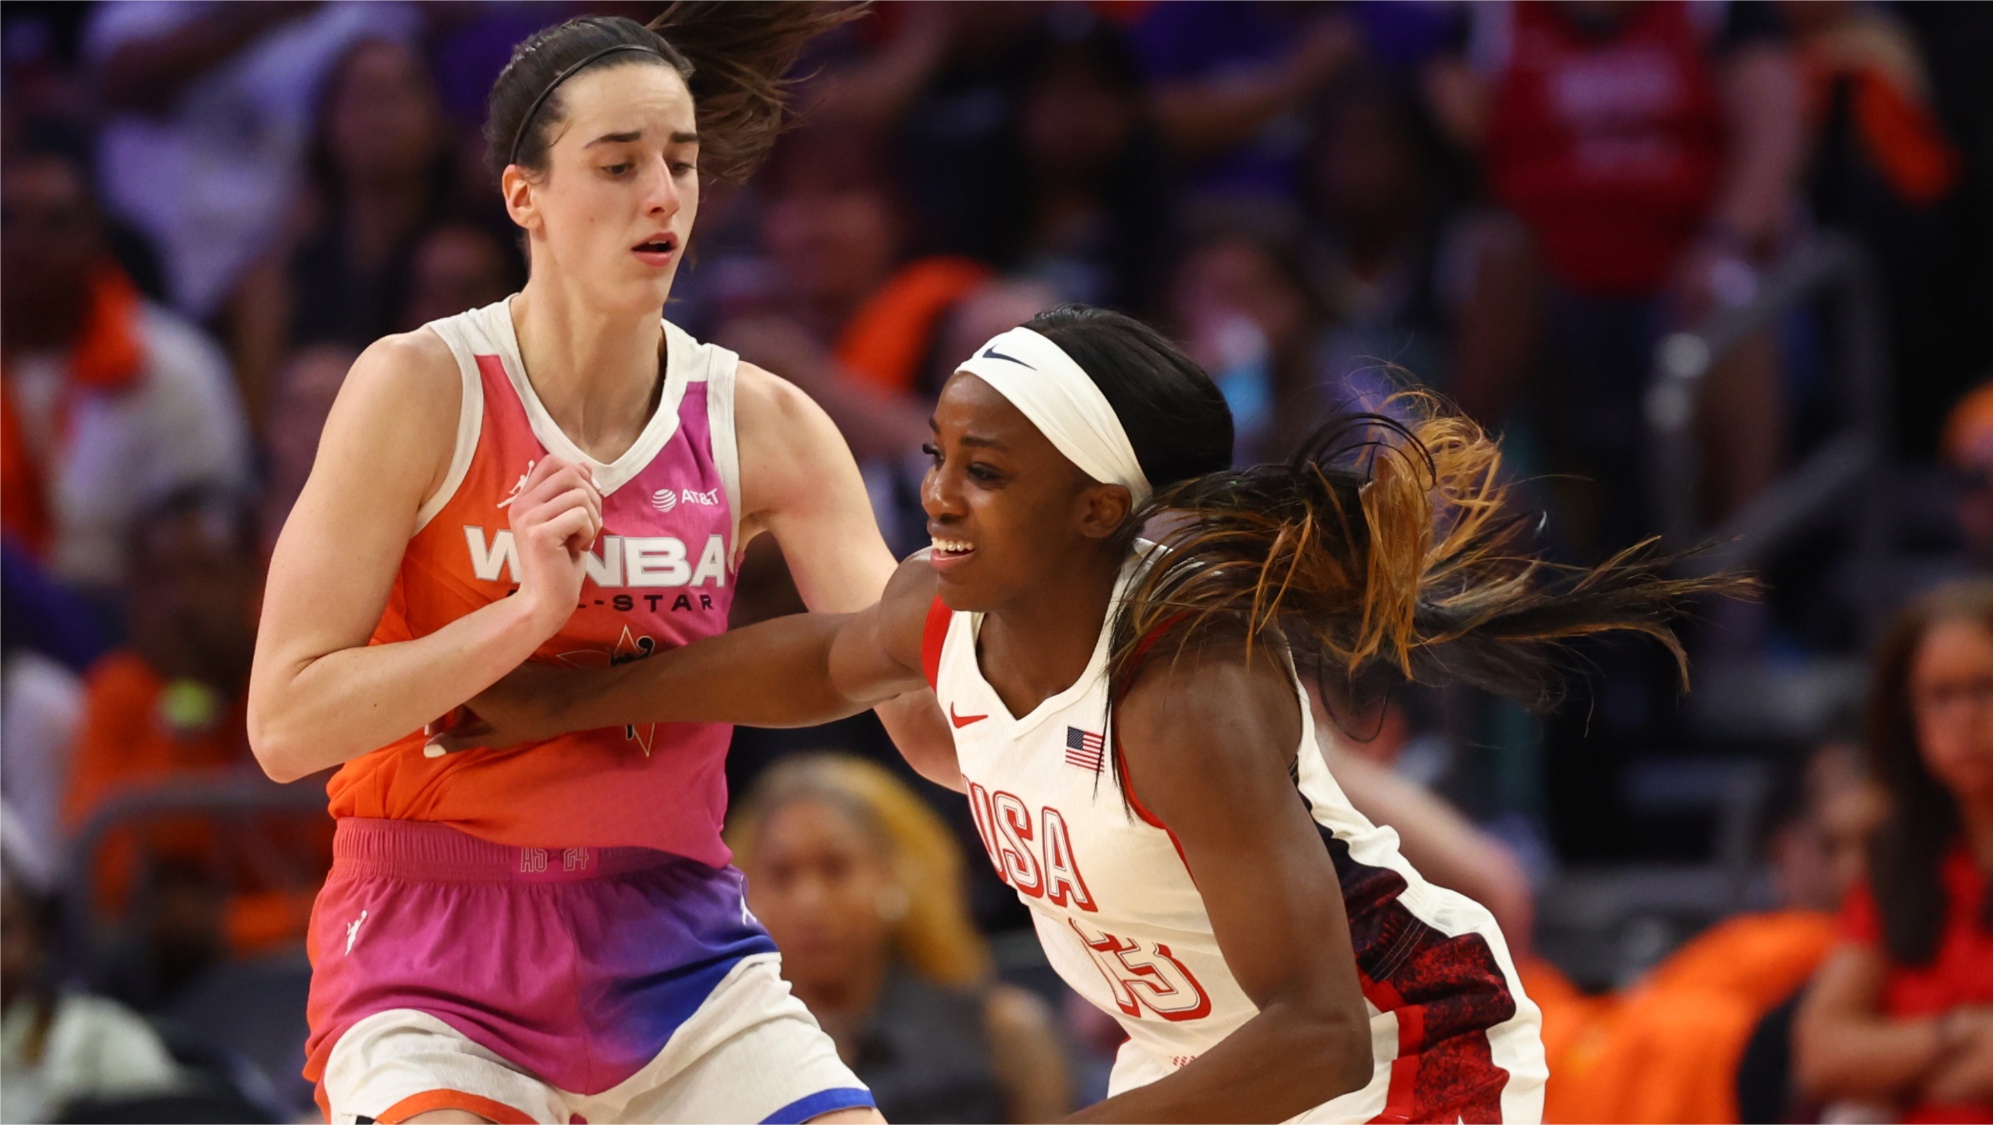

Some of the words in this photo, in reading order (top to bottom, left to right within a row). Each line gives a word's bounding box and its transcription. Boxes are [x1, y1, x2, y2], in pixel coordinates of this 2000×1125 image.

[681, 488, 719, 506] AT&T
[506, 589, 714, 613] -STAR
[962, 773, 1098, 913] USA
[520, 847, 548, 873] AS
[563, 846, 590, 872] 24
